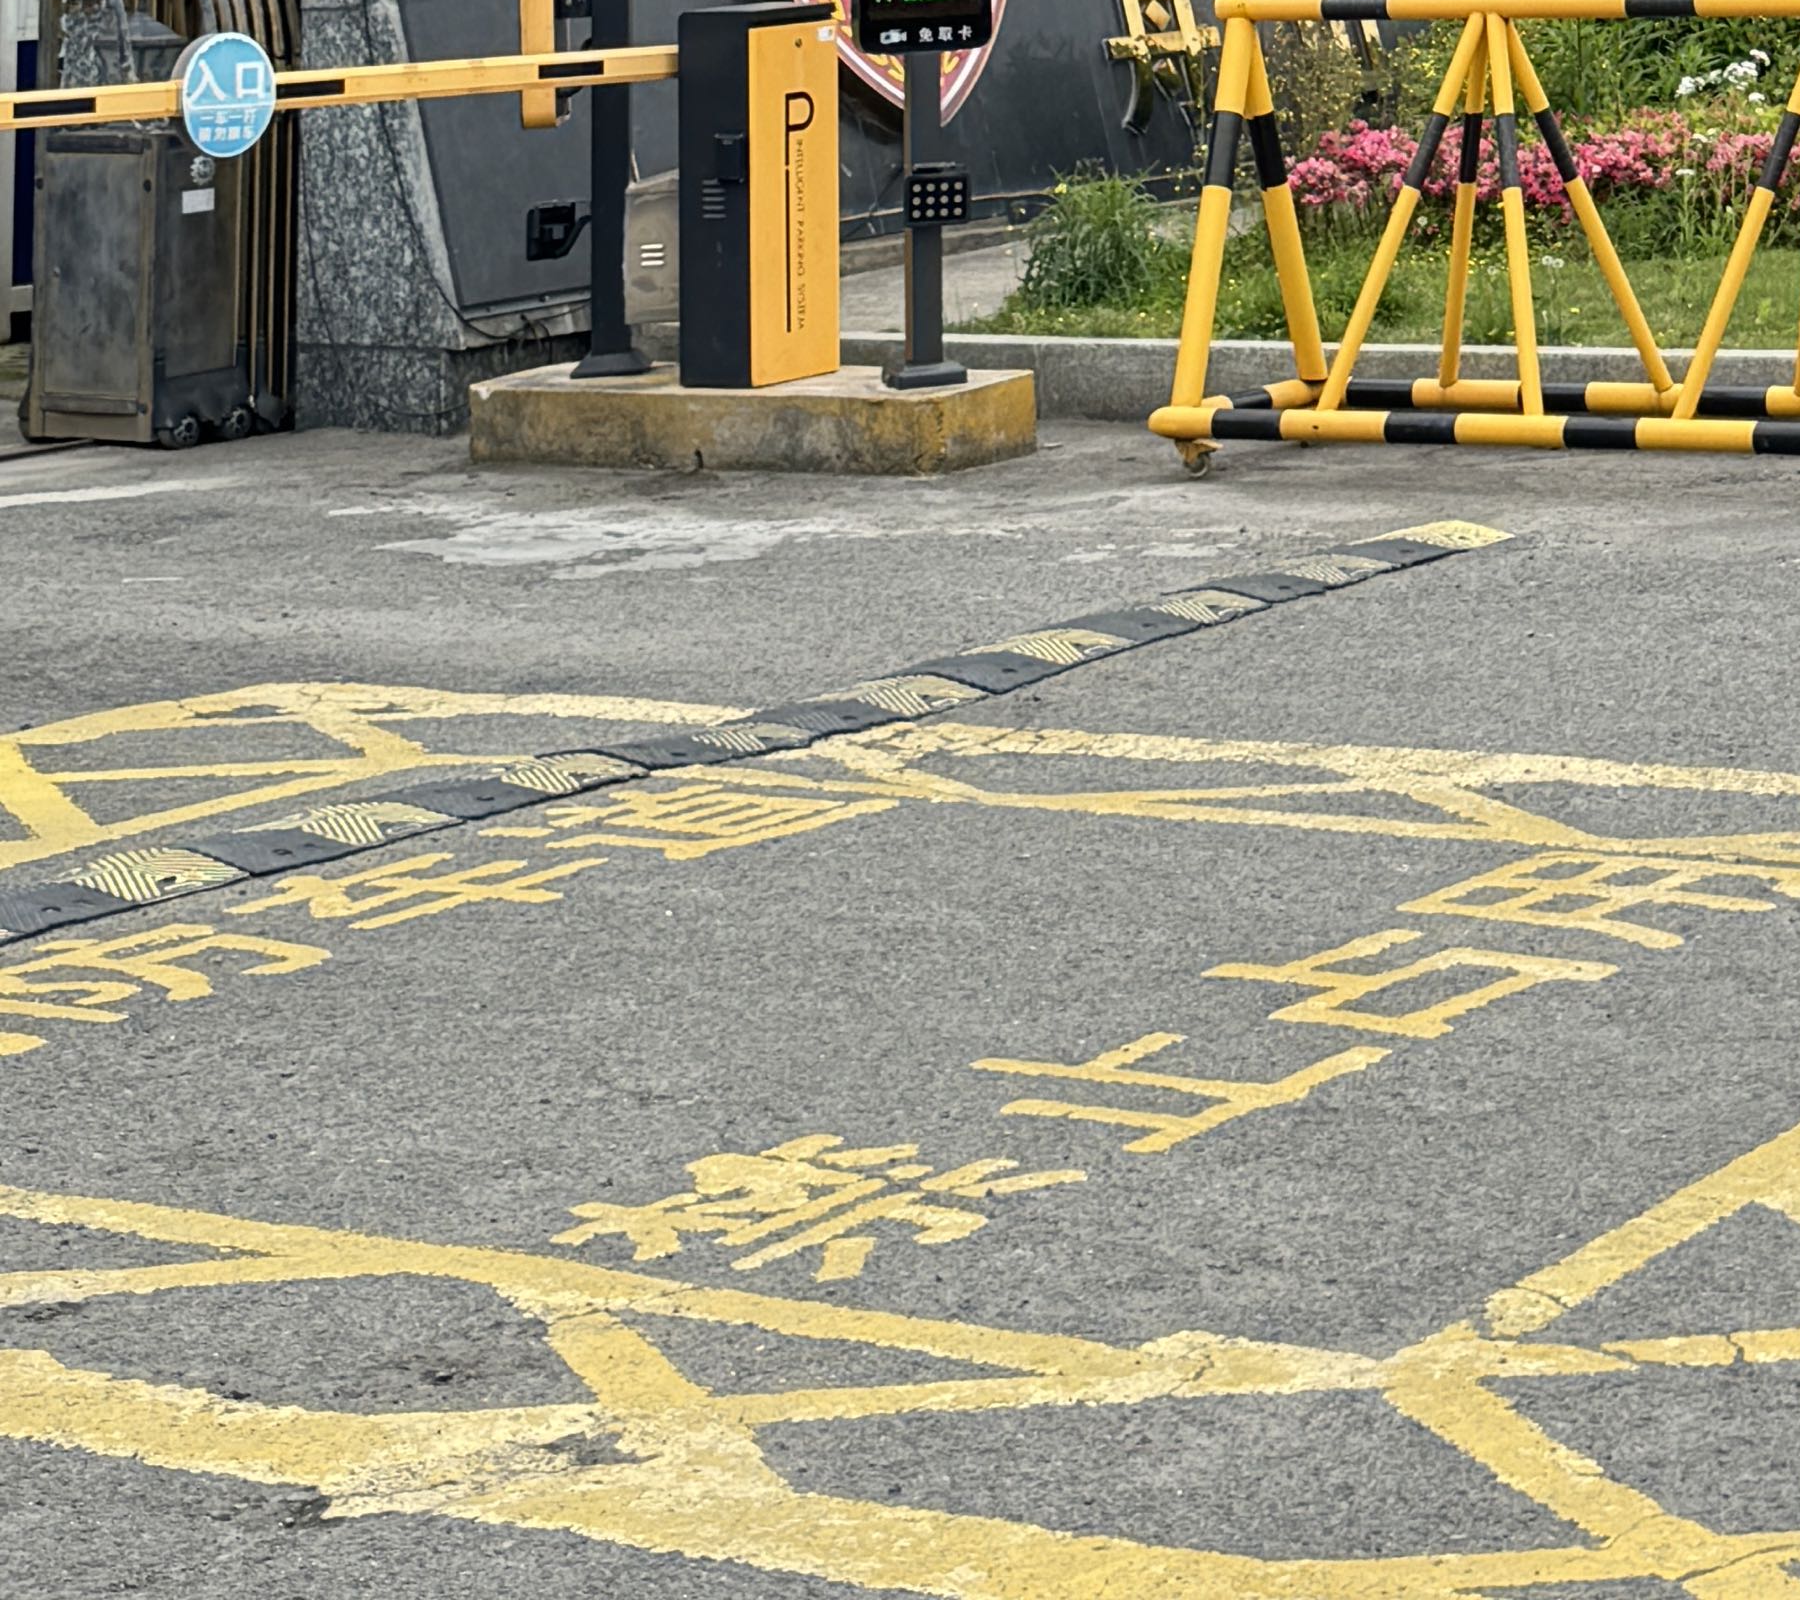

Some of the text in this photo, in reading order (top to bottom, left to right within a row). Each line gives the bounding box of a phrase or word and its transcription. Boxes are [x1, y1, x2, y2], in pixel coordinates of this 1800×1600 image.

[919, 25, 973, 42] 免取卡
[190, 59, 265, 101] 入口
[0, 783, 900, 1056] 防车道
